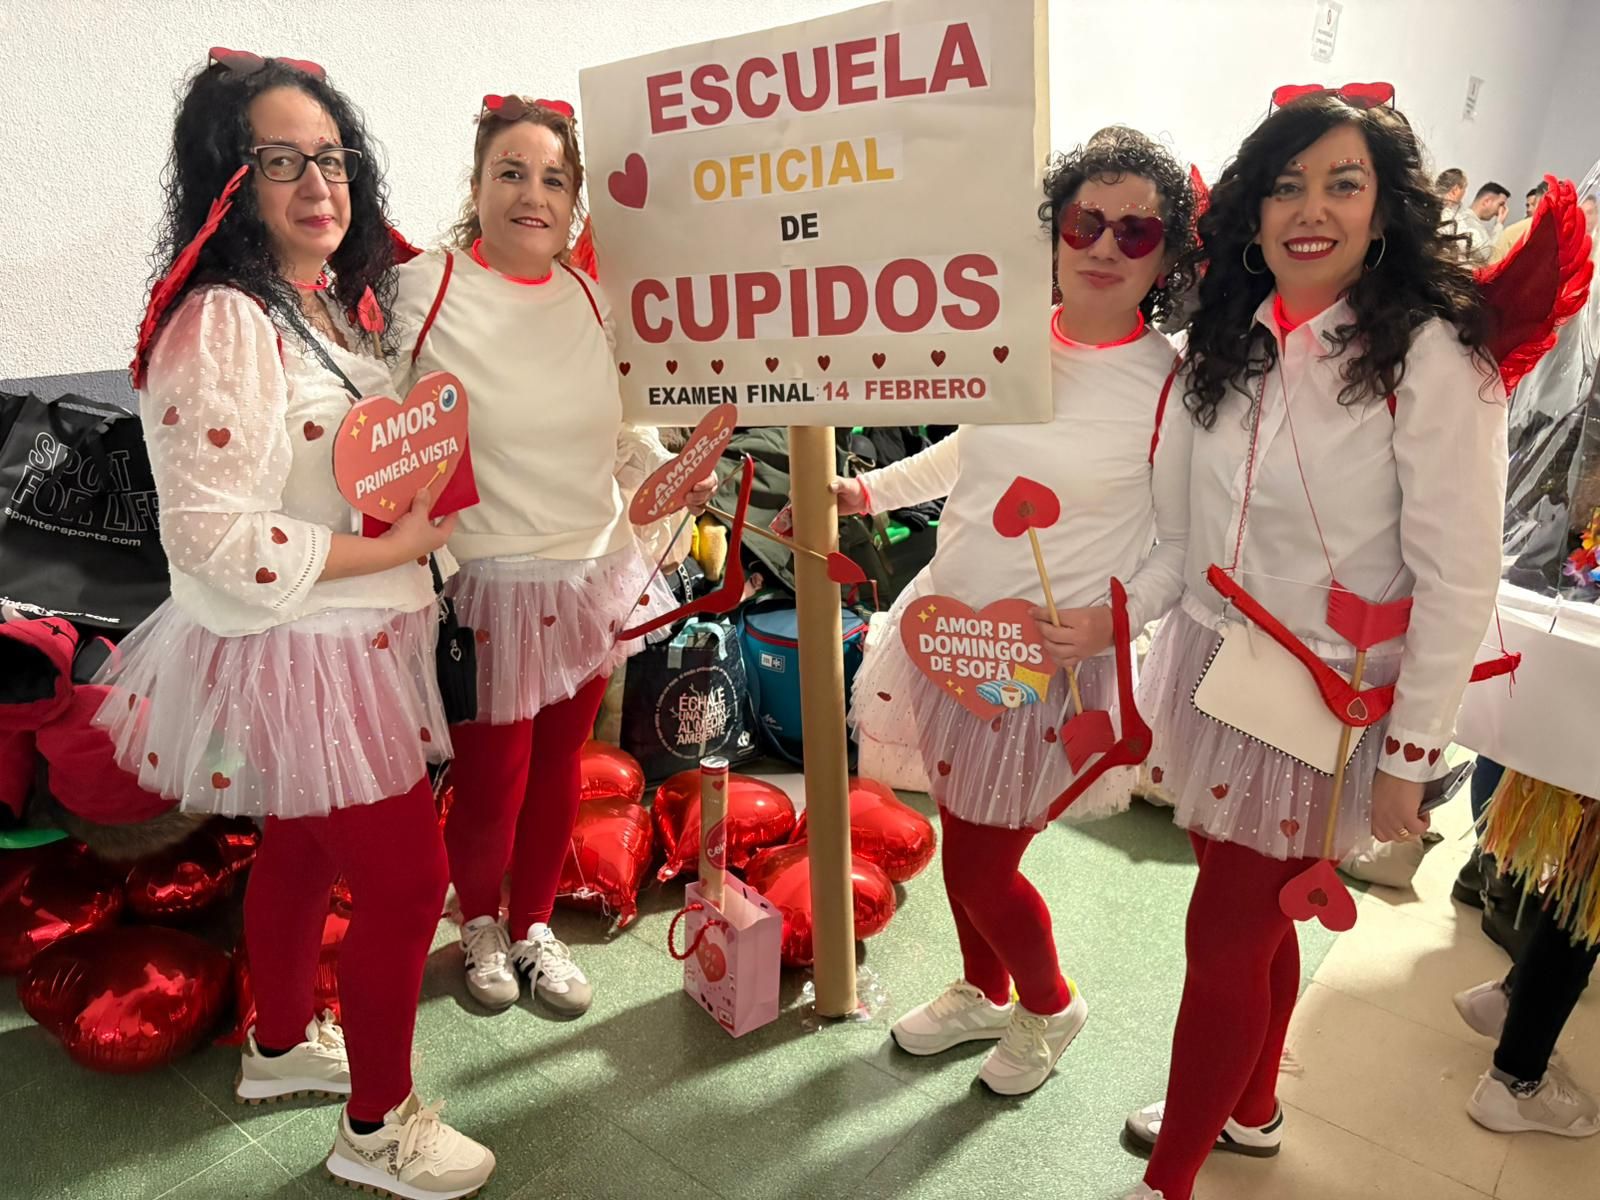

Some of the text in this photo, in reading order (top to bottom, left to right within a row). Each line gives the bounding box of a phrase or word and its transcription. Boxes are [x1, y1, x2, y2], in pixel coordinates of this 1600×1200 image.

[647, 22, 988, 134] ESCUELA
[693, 137, 894, 201] OFICIAL
[781, 213, 819, 241] DE
[631, 253, 1001, 343] CUPIDOS
[649, 385, 737, 405] EXAMEN
[823, 381, 849, 401] 14
[865, 377, 987, 401] FEBRERO
[371, 401, 437, 453] AMOR
[401, 439, 411, 455] A
[355, 436, 459, 499] PRIMERA VISTA
[648, 427, 729, 516] VERDADERO
[655, 434, 711, 499] AMOR
[4, 506, 141, 547] sprintersports.com
[935, 616, 1022, 640] AMOR DE
[919, 634, 1043, 665] DOMINGOS
[930, 656, 952, 673] DE
[679, 685, 726, 712] ÉCHALE
[678, 711, 700, 721] UNA
[678, 716, 727, 734] AL MEDIO
[676, 727, 726, 746] AMBIENTE
